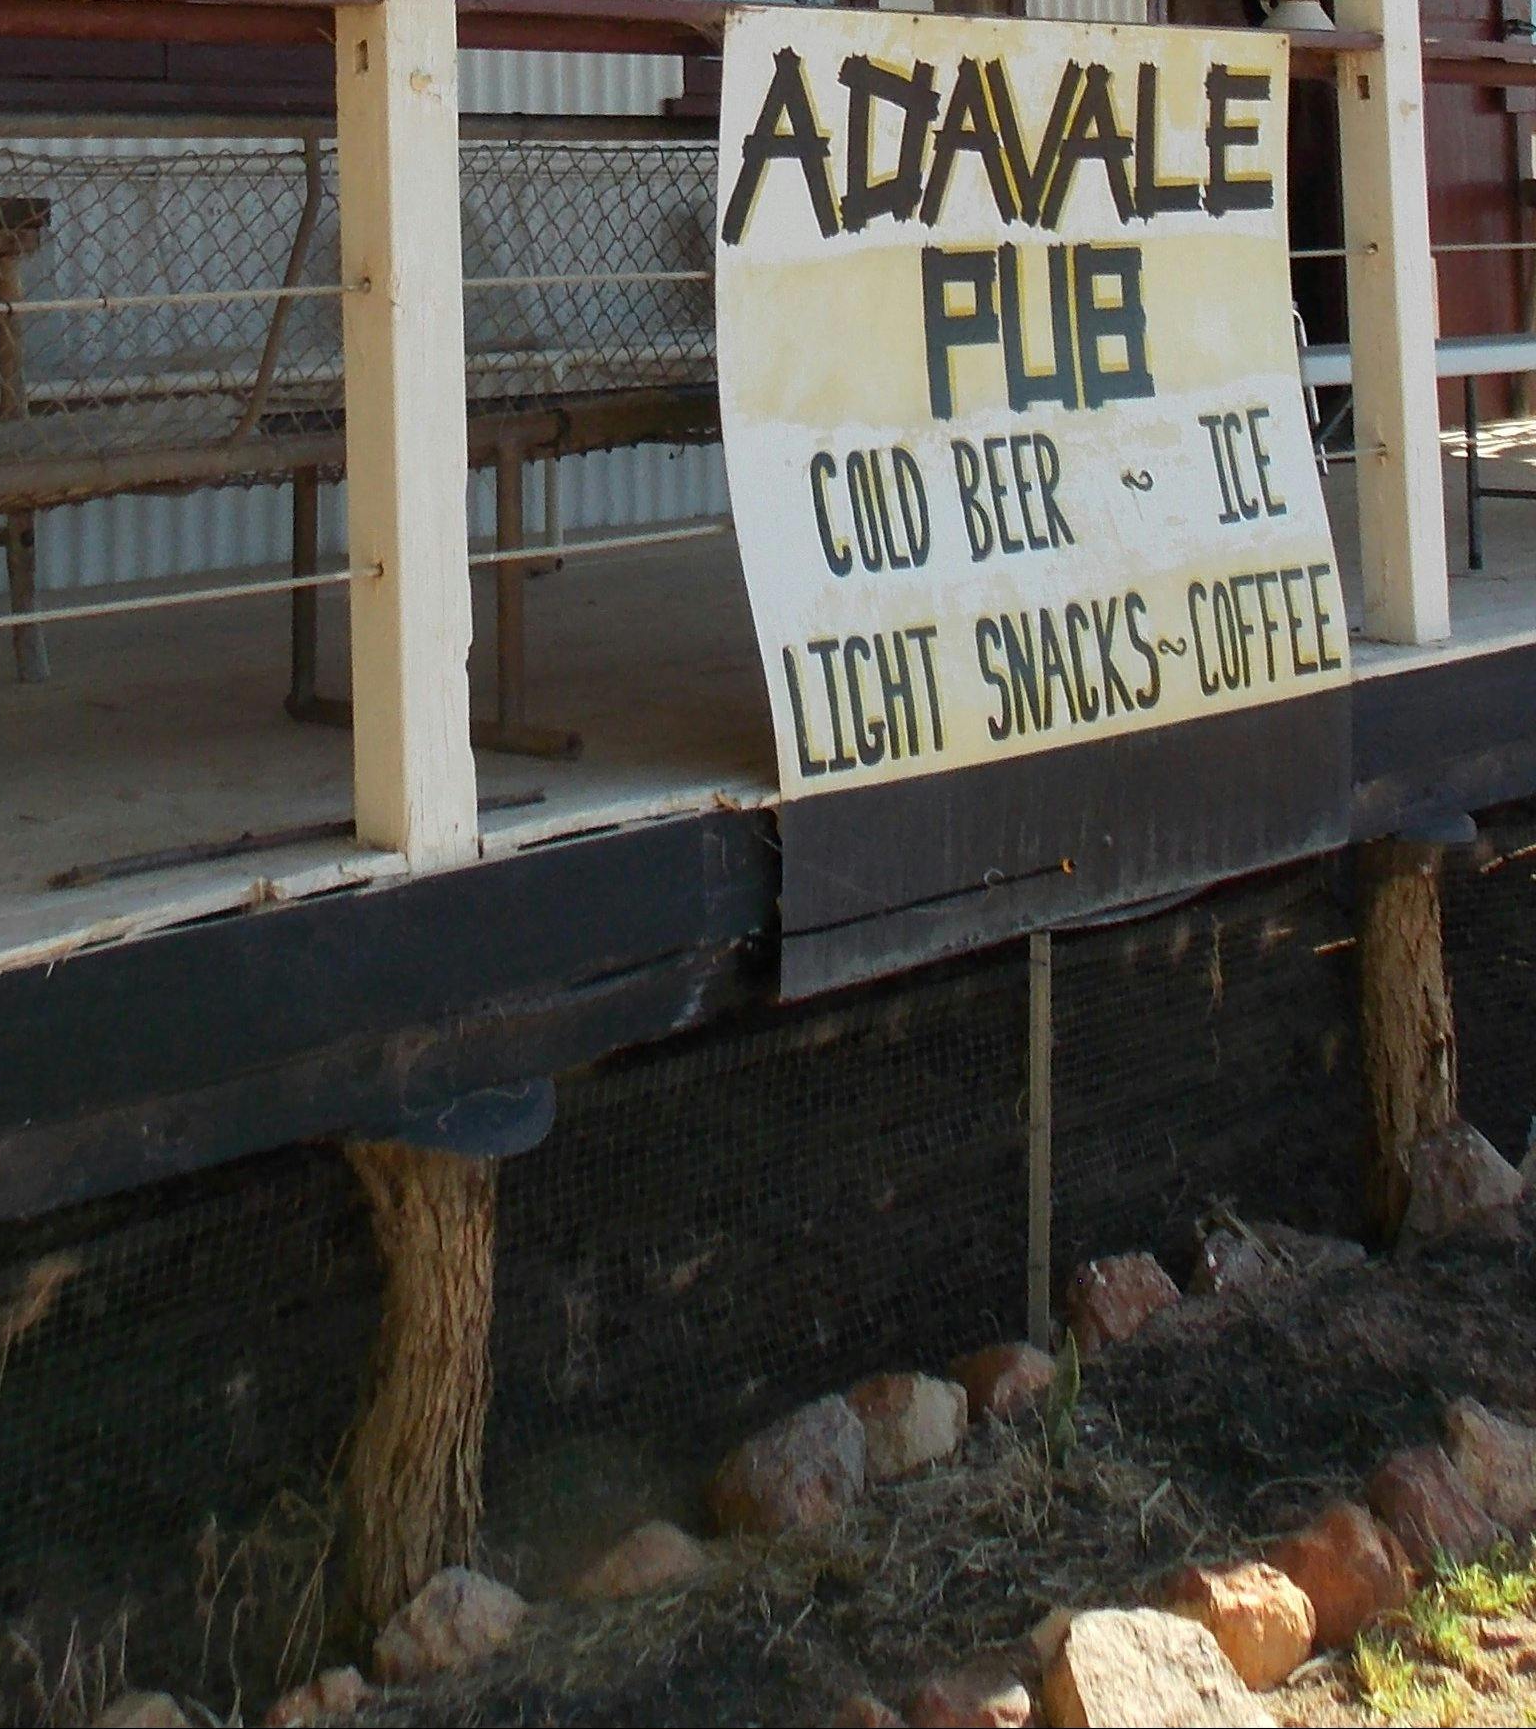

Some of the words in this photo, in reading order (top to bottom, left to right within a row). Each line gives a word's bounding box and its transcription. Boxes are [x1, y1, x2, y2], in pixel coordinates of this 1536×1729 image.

[721, 45, 1275, 246] ADAVALE
[920, 239, 1157, 421] PUB
[809, 446, 932, 578] COLD
[950, 432, 1076, 563] BEER
[1198, 408, 1287, 525] ICE
[781, 625, 945, 777] LIGHT
[975, 591, 1162, 742] SNACKS
[1187, 563, 1342, 698] COFFEE
